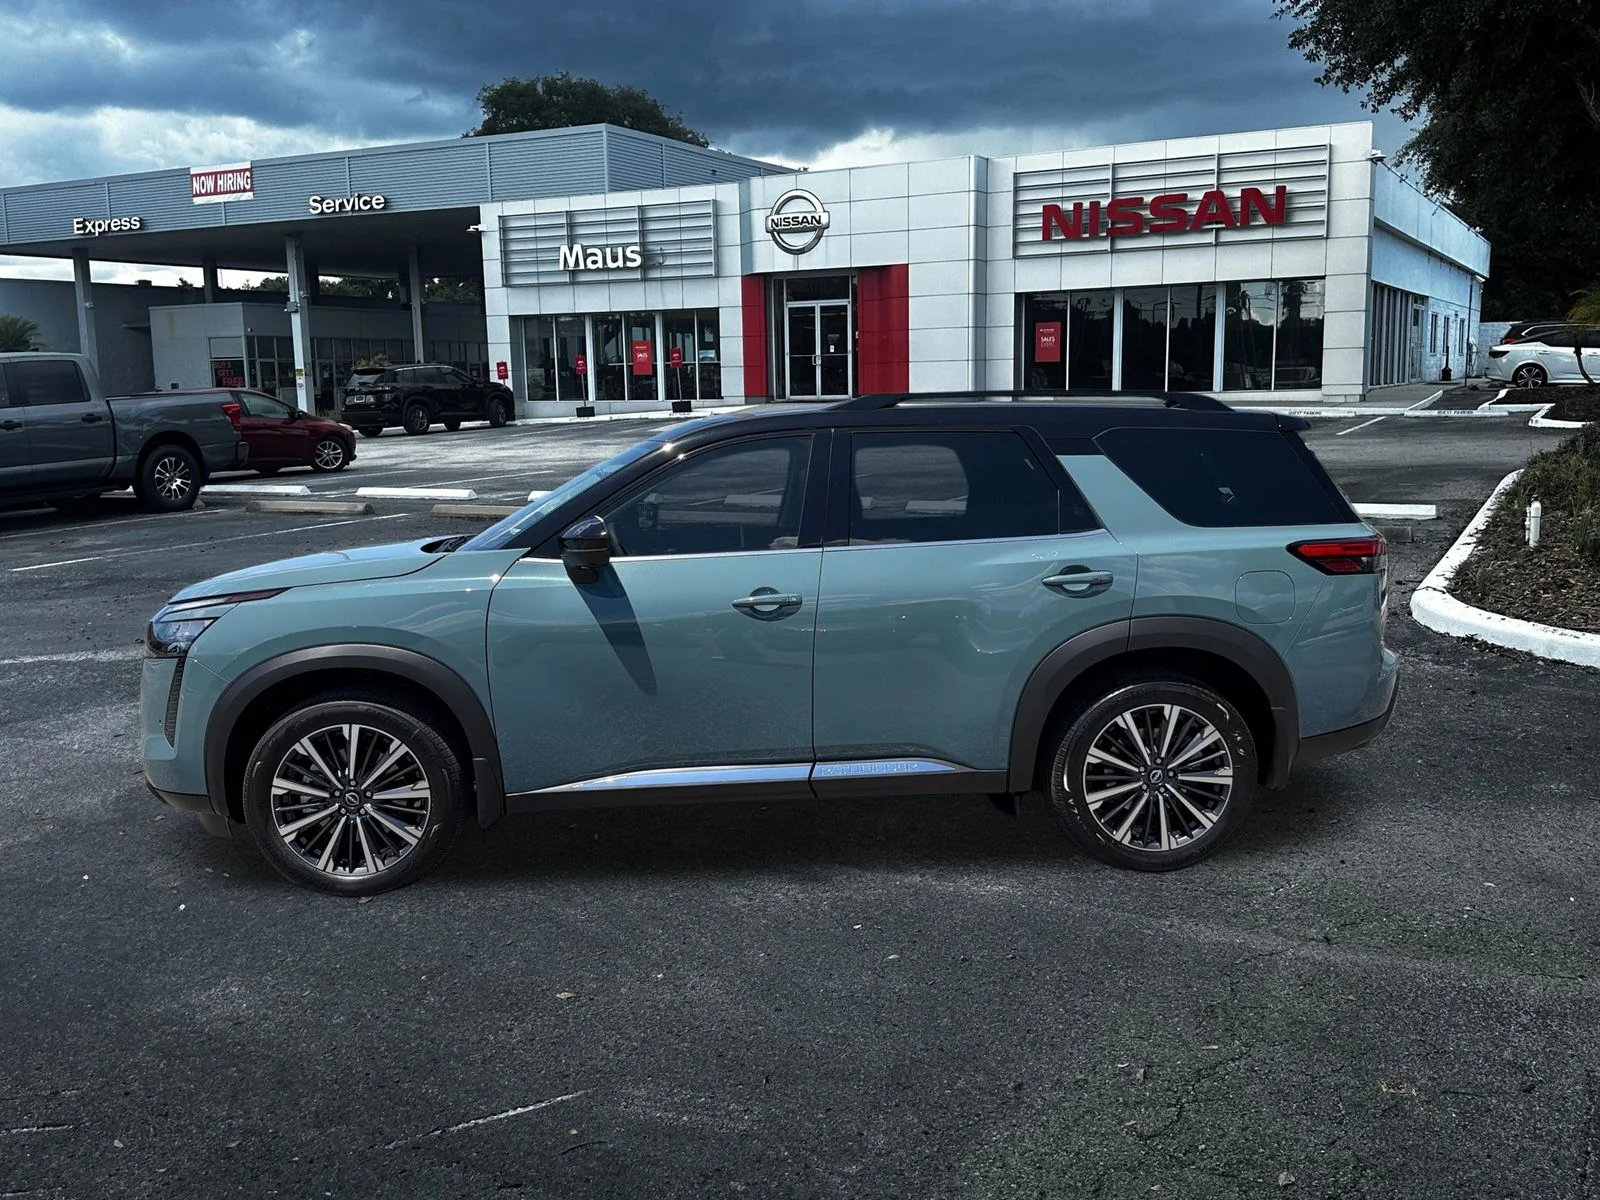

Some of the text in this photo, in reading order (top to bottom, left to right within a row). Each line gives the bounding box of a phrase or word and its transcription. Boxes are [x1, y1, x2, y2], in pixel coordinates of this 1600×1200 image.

[192, 171, 251, 194] NOW HIRING
[309, 193, 385, 214] Service
[1042, 185, 1287, 241] NISSAN
[73, 216, 141, 237] Express
[770, 215, 822, 228] NISSAN
[559, 244, 642, 271] Maus
